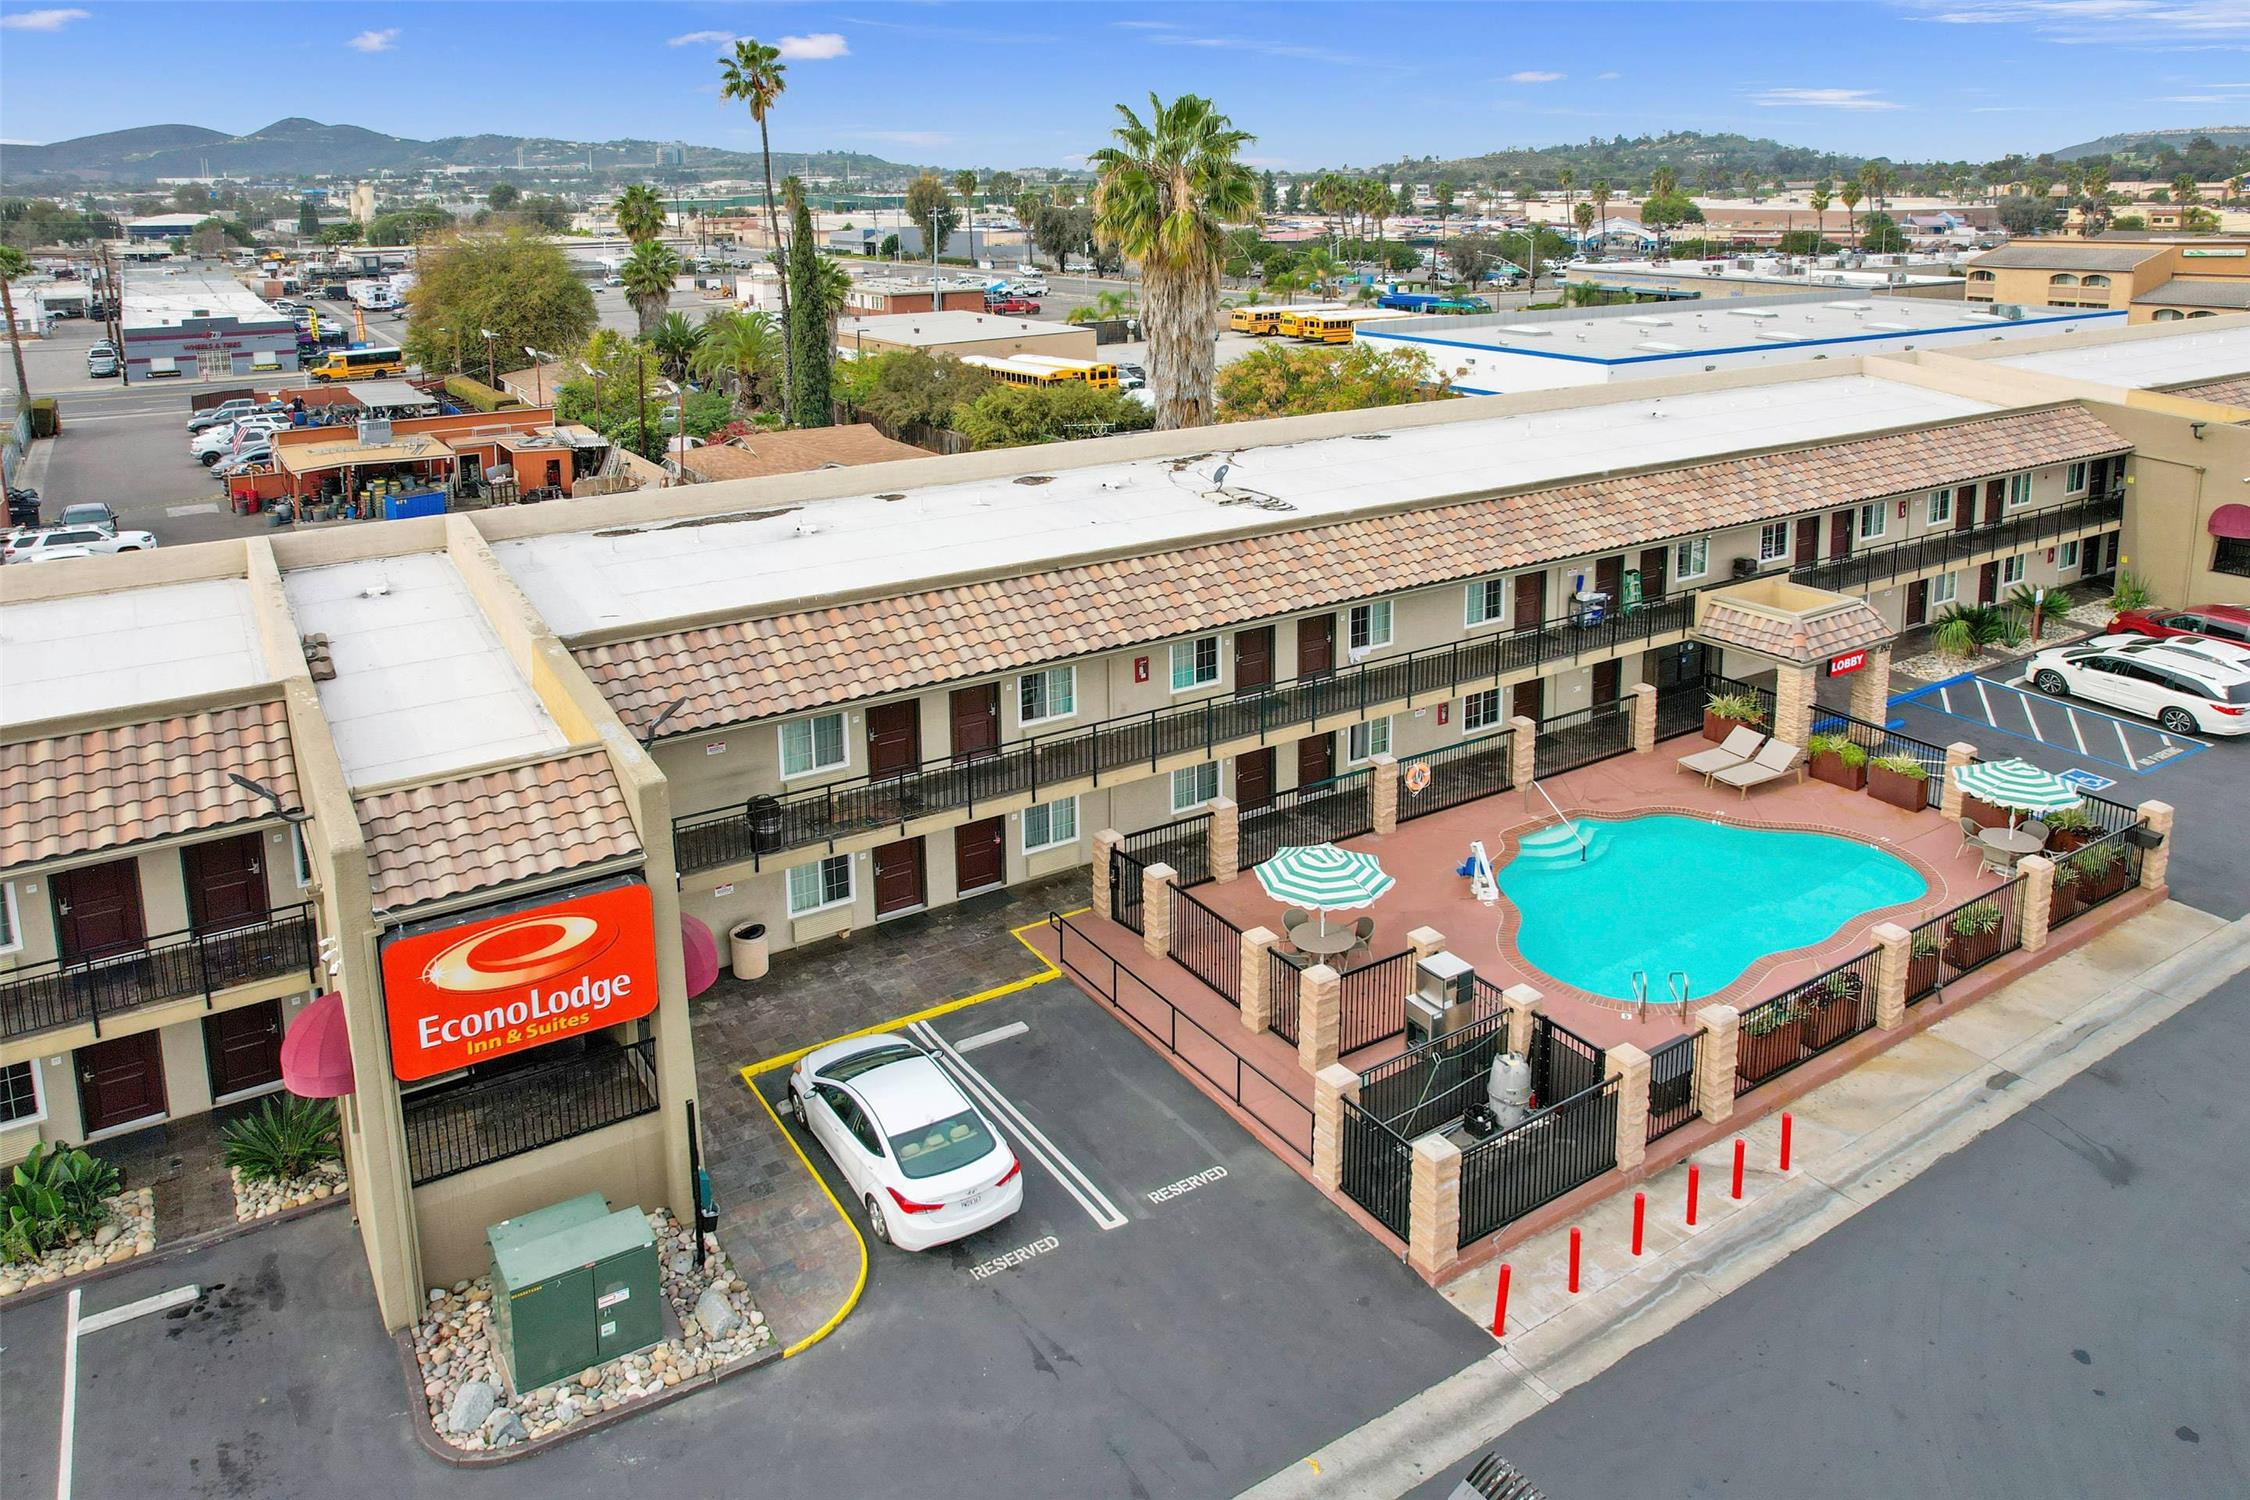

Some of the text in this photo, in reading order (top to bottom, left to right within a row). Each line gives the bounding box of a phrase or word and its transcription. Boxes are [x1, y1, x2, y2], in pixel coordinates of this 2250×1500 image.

[1831, 653, 1864, 672] LOBBY
[418, 973, 632, 1049] EconoLodge
[466, 1012, 590, 1056] Inn & Suites
[1147, 1165, 1228, 1204] RESERVED
[969, 1235, 1060, 1281] RESERVED
